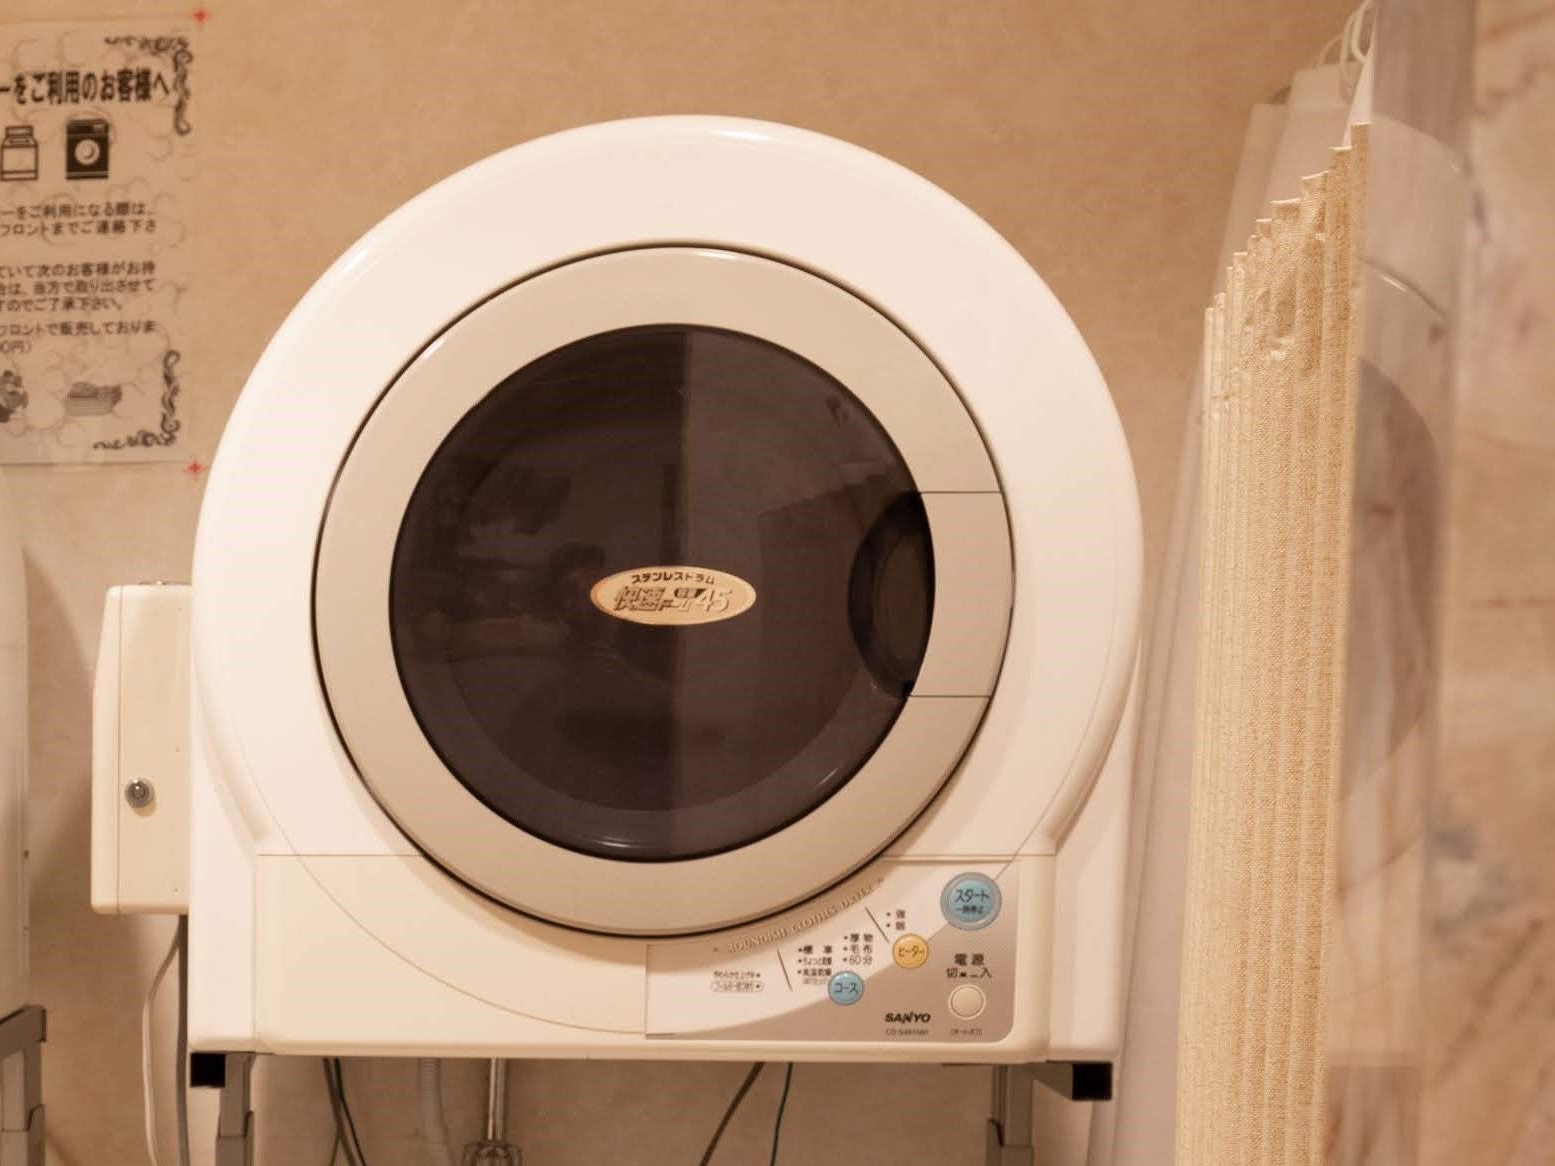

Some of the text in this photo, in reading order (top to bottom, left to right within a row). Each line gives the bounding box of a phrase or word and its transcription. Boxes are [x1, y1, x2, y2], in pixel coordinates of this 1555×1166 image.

[955, 888, 990, 904] スタート
[898, 945, 924, 957] ヒーター
[834, 982, 859, 994] コース
[885, 1010, 931, 1024] SANYO
